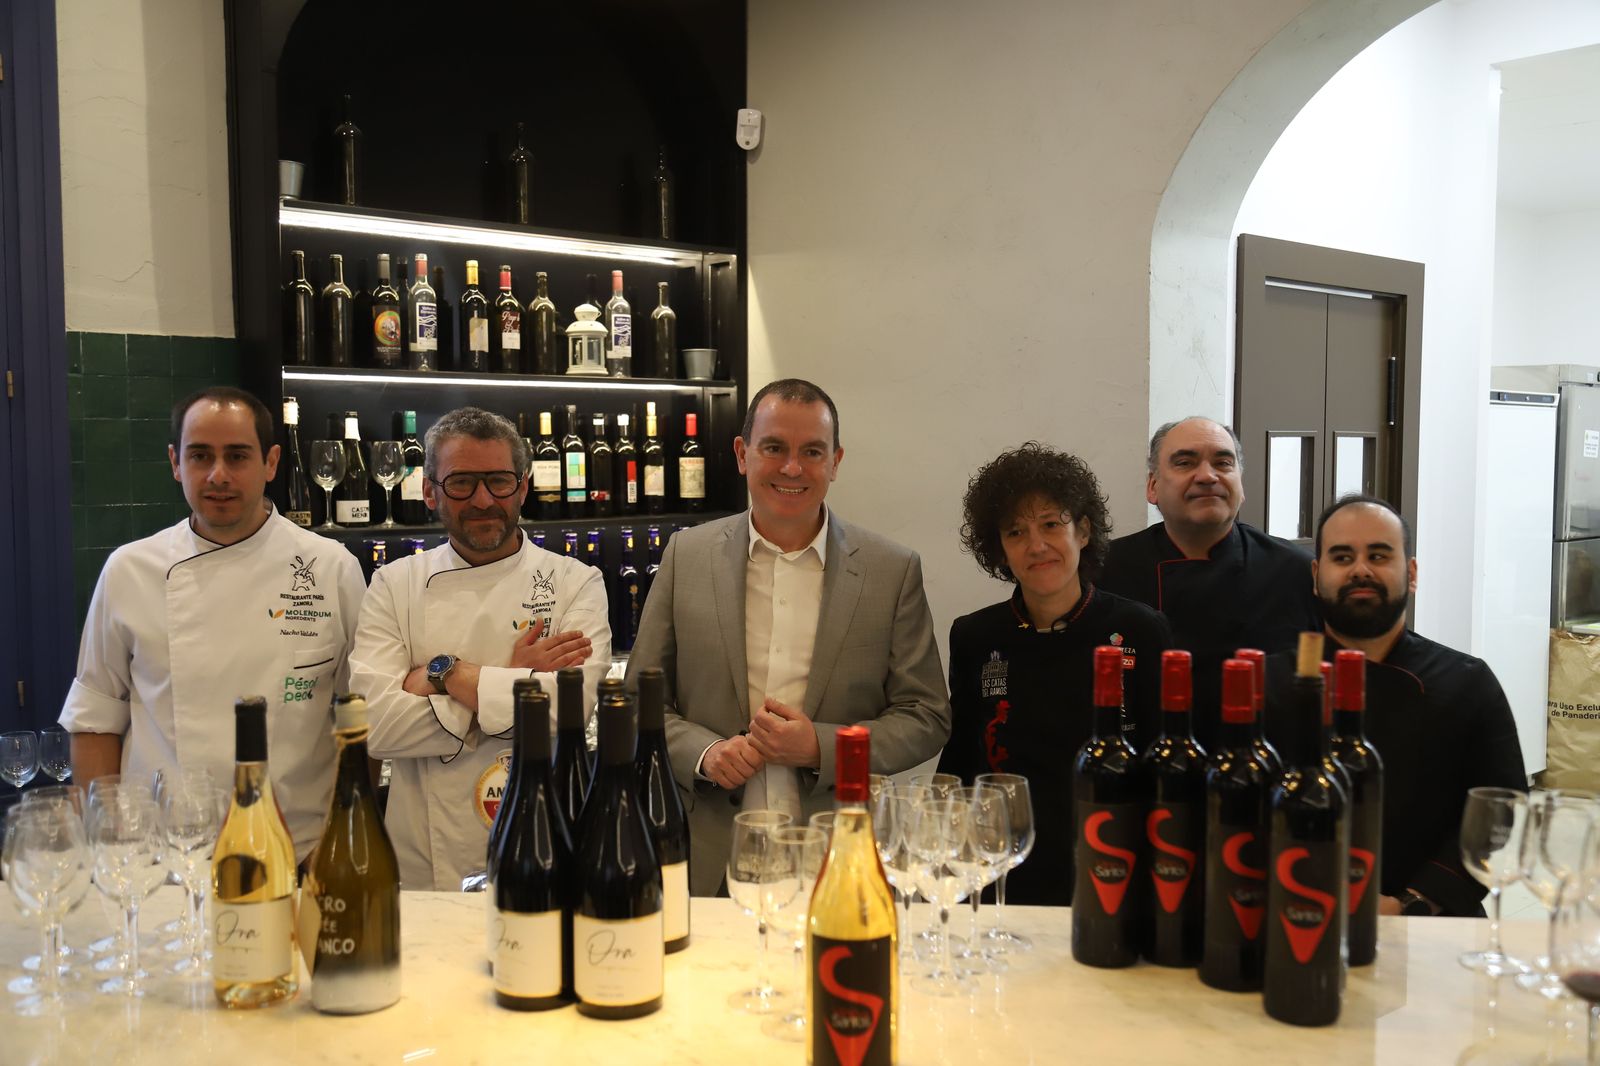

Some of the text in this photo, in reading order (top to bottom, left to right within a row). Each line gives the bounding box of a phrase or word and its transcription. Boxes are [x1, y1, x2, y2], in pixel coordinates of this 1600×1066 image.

[286, 609, 331, 617] MOLENDUM
[1559, 701, 1574, 710] Uso
[1551, 709, 1561, 717] de
